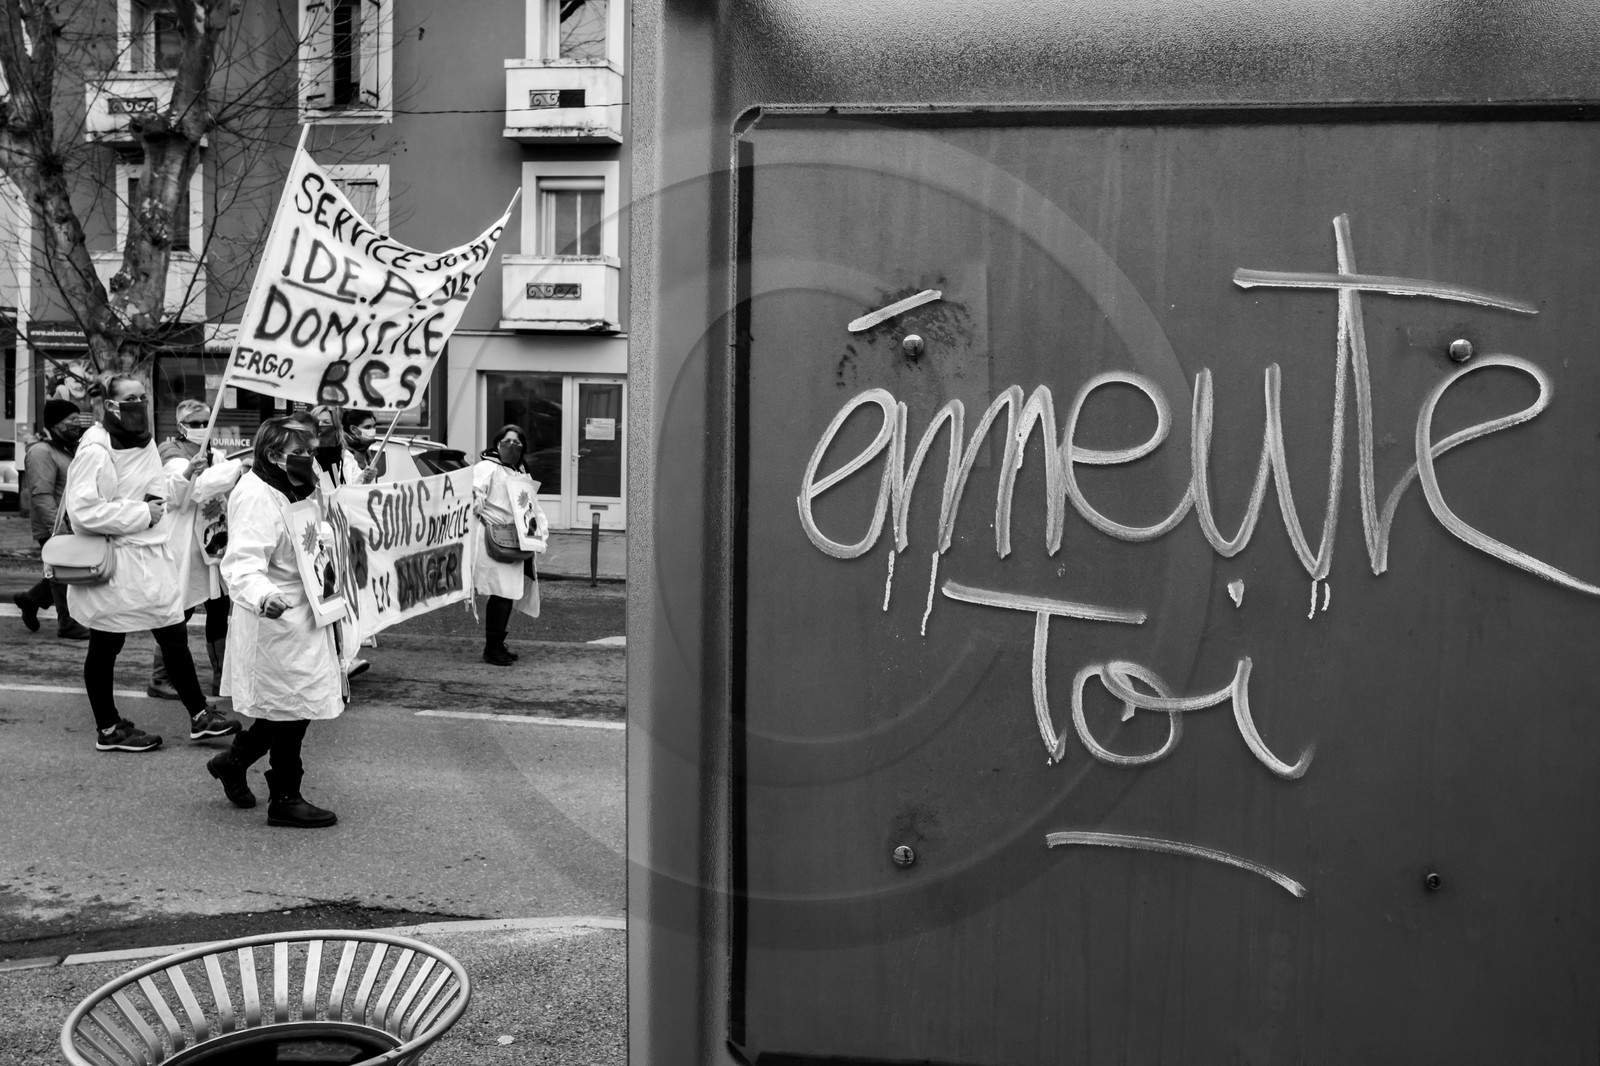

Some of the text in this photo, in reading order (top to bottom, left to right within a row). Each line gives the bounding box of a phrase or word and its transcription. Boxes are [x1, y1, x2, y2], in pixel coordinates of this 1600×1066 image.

[212, 438, 251, 447] DURANCE
[395, 551, 459, 612] DANGER
[942, 580, 1318, 779] Toi
